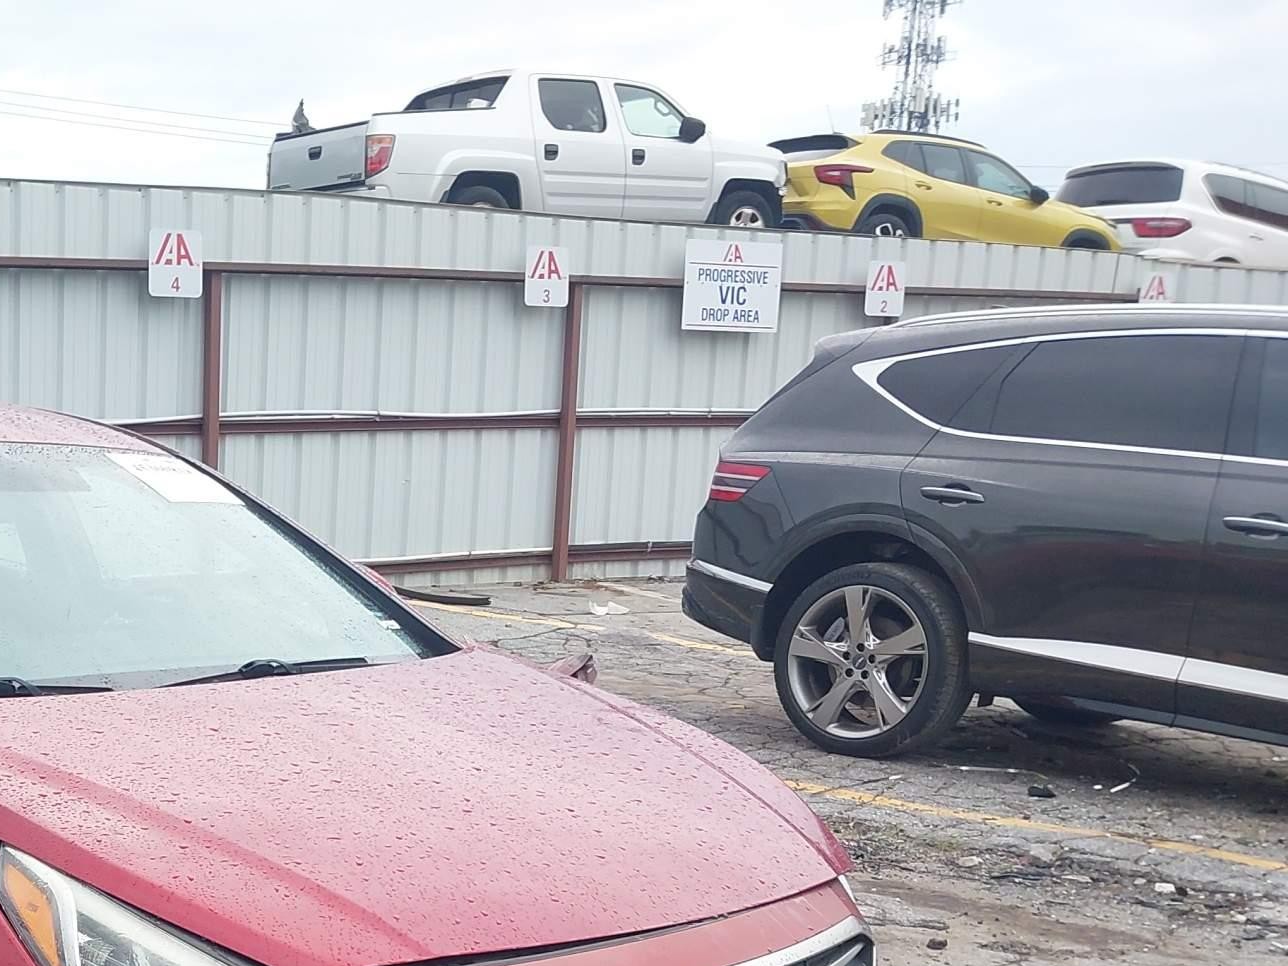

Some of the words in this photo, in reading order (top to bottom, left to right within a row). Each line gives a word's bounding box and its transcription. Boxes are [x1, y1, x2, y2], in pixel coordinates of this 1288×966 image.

[171, 276, 181, 292] 4
[698, 267, 769, 285] PROGRESSIVE
[543, 289, 551, 303] 3
[718, 285, 747, 305] VIC
[880, 300, 888, 313] 2
[701, 307, 730, 322] DROP
[732, 308, 760, 323] AREA
